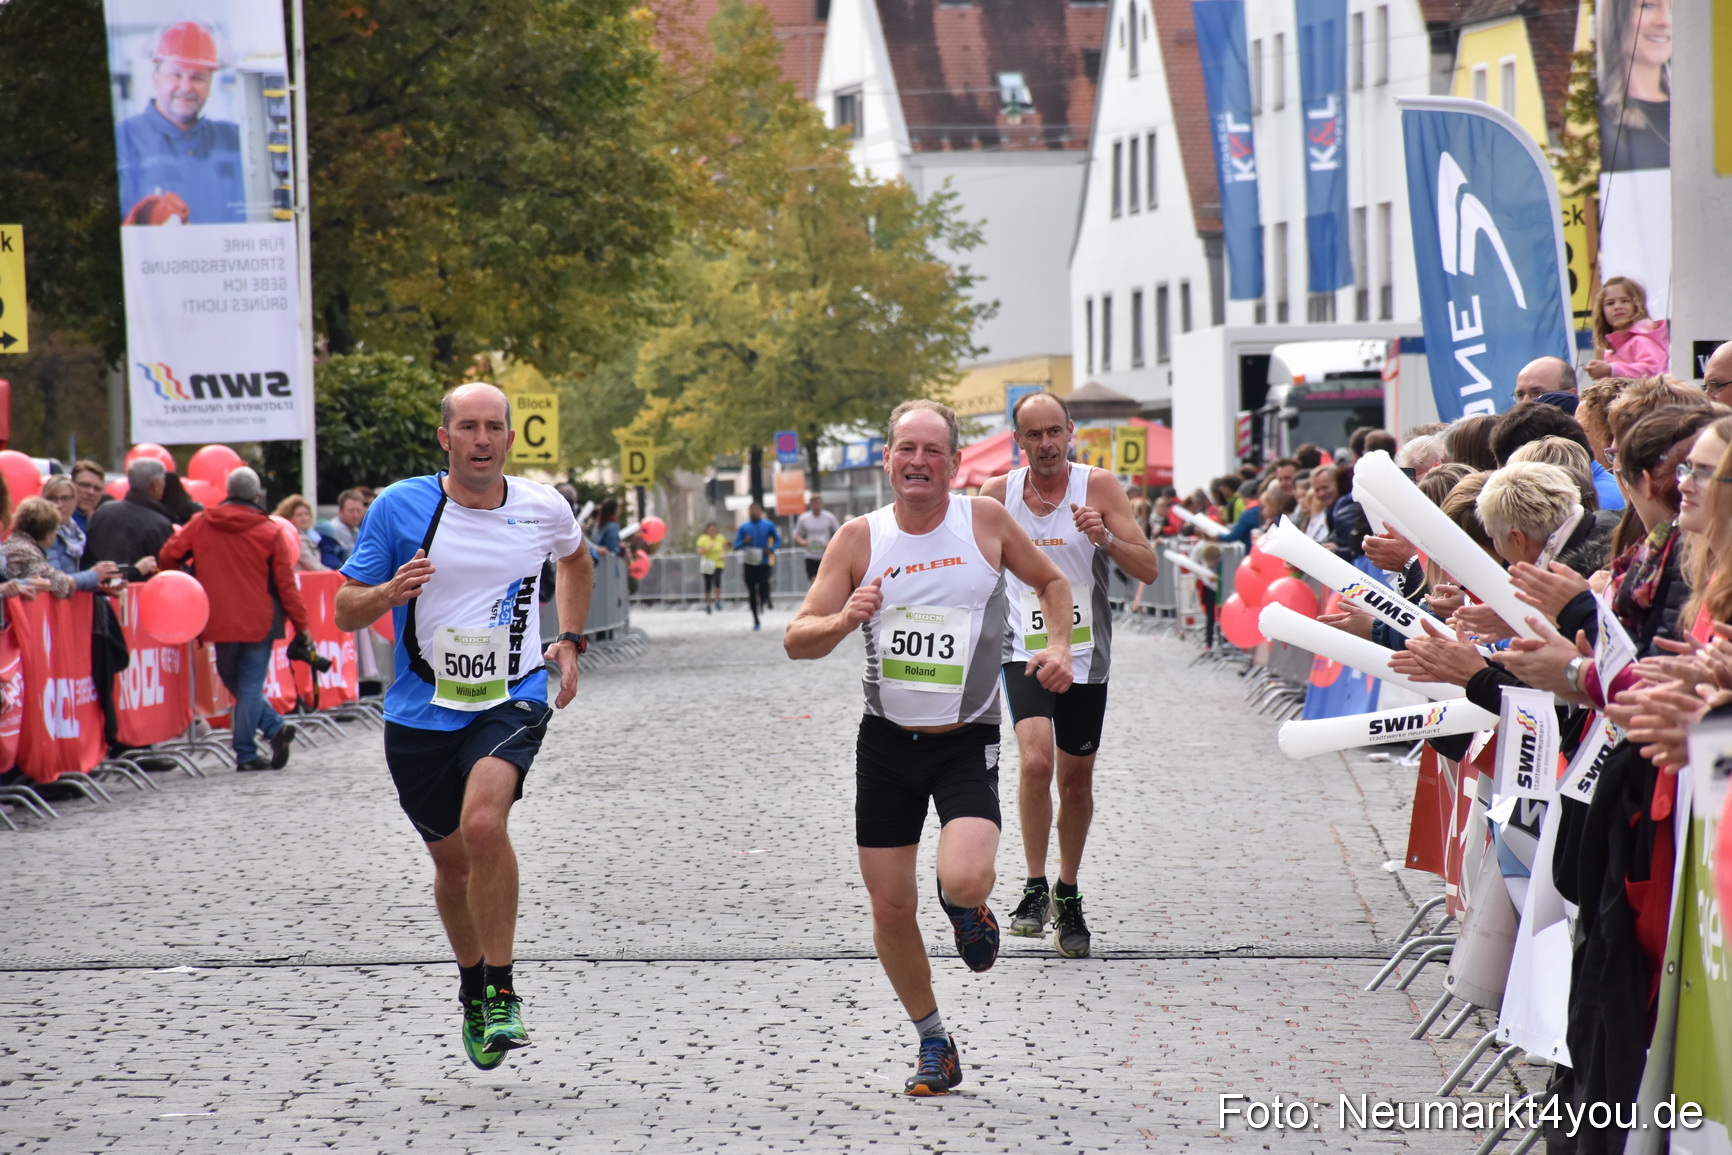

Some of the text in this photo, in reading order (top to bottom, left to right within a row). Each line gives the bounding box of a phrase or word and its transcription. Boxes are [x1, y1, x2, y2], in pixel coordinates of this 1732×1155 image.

[1307, 94, 1339, 172] K&L
[517, 397, 552, 409] Block
[524, 414, 546, 447] C
[629, 451, 646, 475] D
[1123, 441, 1140, 464] D
[905, 557, 968, 575] KLEBL
[489, 598, 503, 621] WASTE
[913, 612, 945, 622] BOCK
[1363, 590, 1416, 627] swn
[461, 636, 491, 645] BOCK
[890, 630, 955, 660] 5013
[445, 651, 497, 679] 5064
[905, 665, 936, 677] Roland
[456, 686, 487, 697] Willibald
[1369, 714, 1424, 735] swn
[1369, 732, 1407, 742] stadtwerke
[1407, 728, 1441, 738] neumarkt
[1517, 733, 1537, 790] swn
[1533, 720, 1545, 791] stadtwerke neumarkt
[1577, 743, 1612, 793] swn
